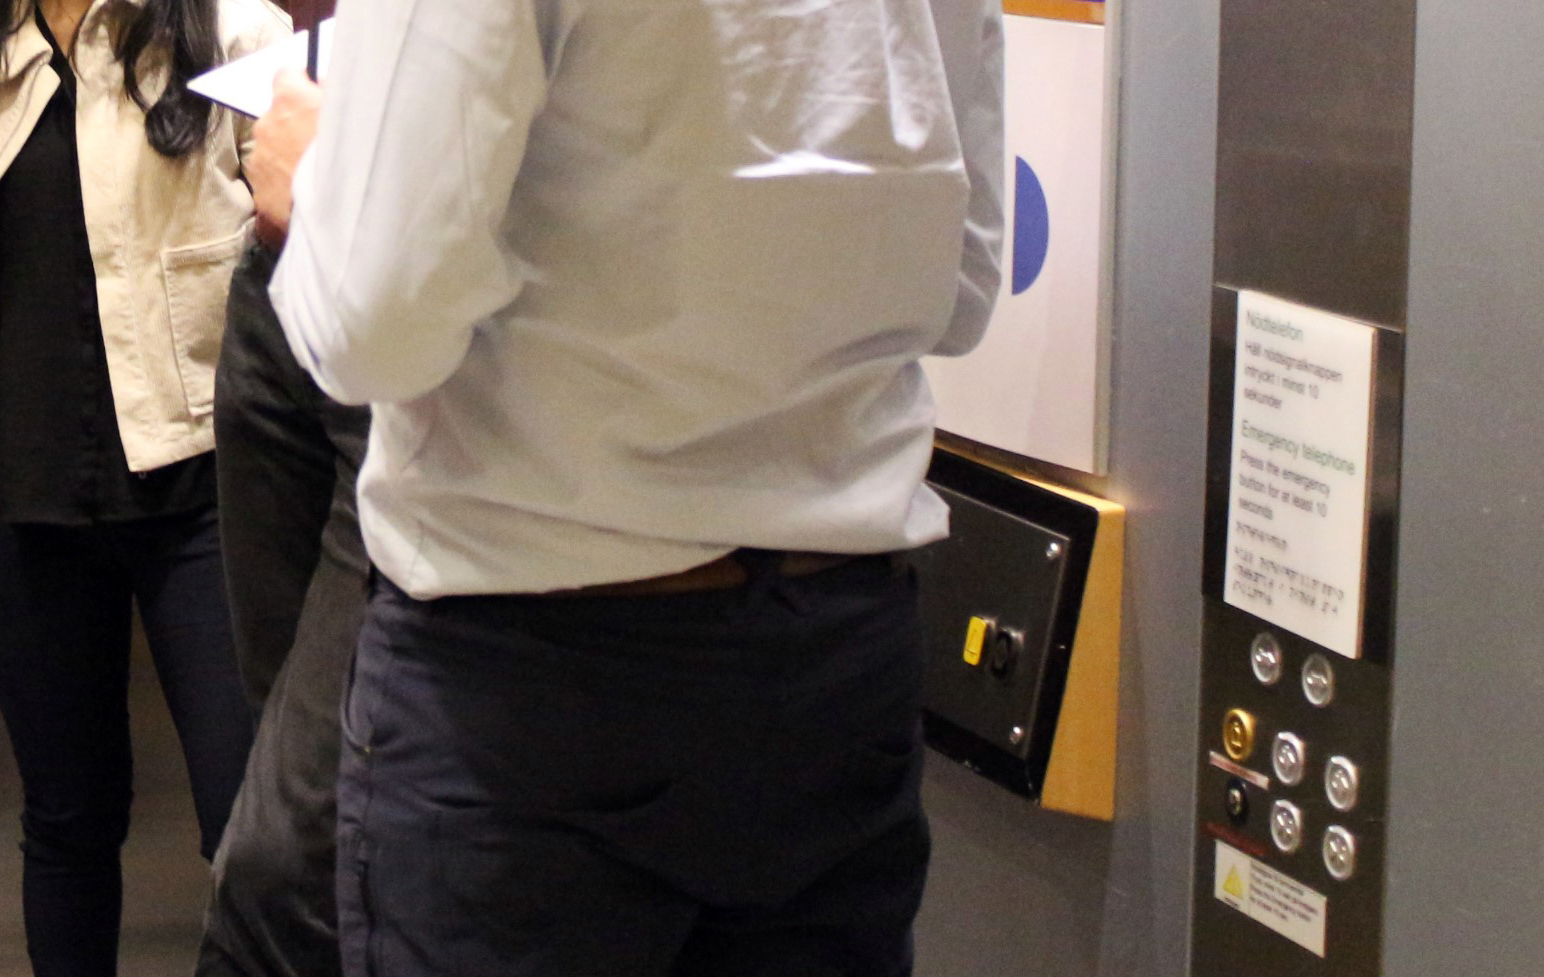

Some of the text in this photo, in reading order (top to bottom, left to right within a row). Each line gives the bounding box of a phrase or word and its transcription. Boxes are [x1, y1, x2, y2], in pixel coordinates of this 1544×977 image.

[1241, 419, 1356, 476] Emergency telephone
[1239, 473, 1266, 493] button
[1268, 482, 1280, 499] for
[1240, 450, 1331, 500] Press the emergency
[1239, 497, 1274, 521] seconds
